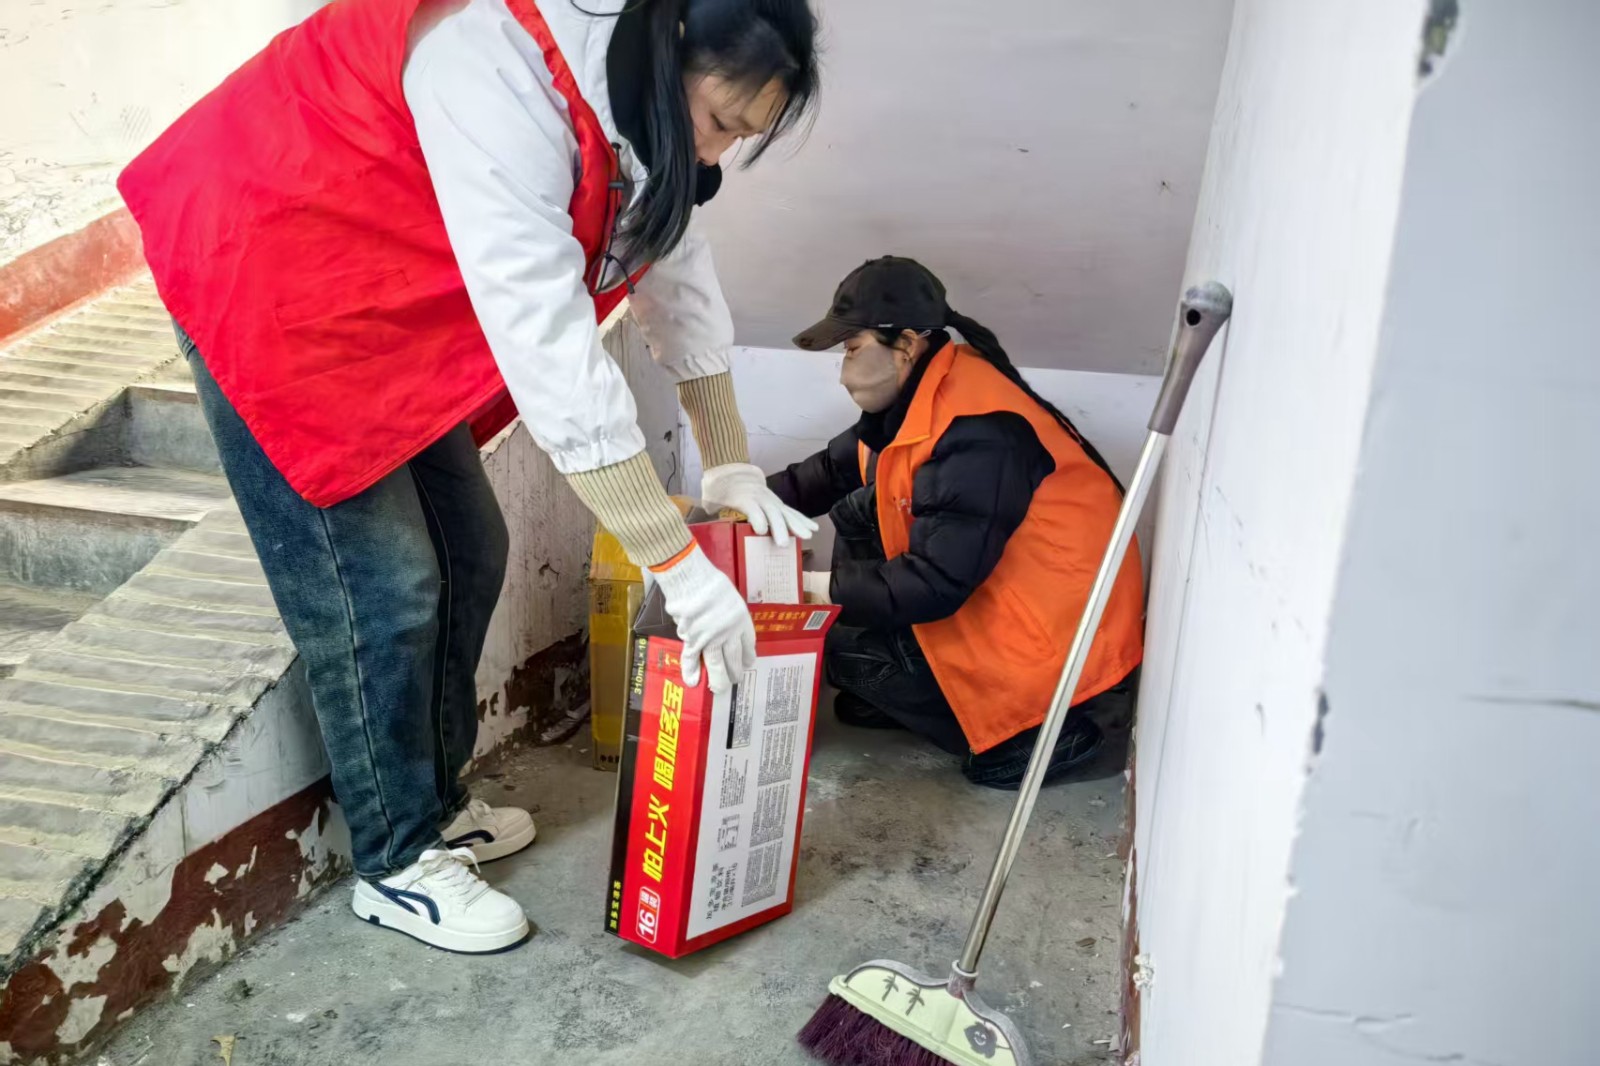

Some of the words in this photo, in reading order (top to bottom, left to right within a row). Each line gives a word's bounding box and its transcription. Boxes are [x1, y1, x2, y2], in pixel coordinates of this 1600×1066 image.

[653, 678, 684, 791] 喝加多宝
[642, 793, 670, 882] 怕上火
[638, 909, 656, 936] 16
